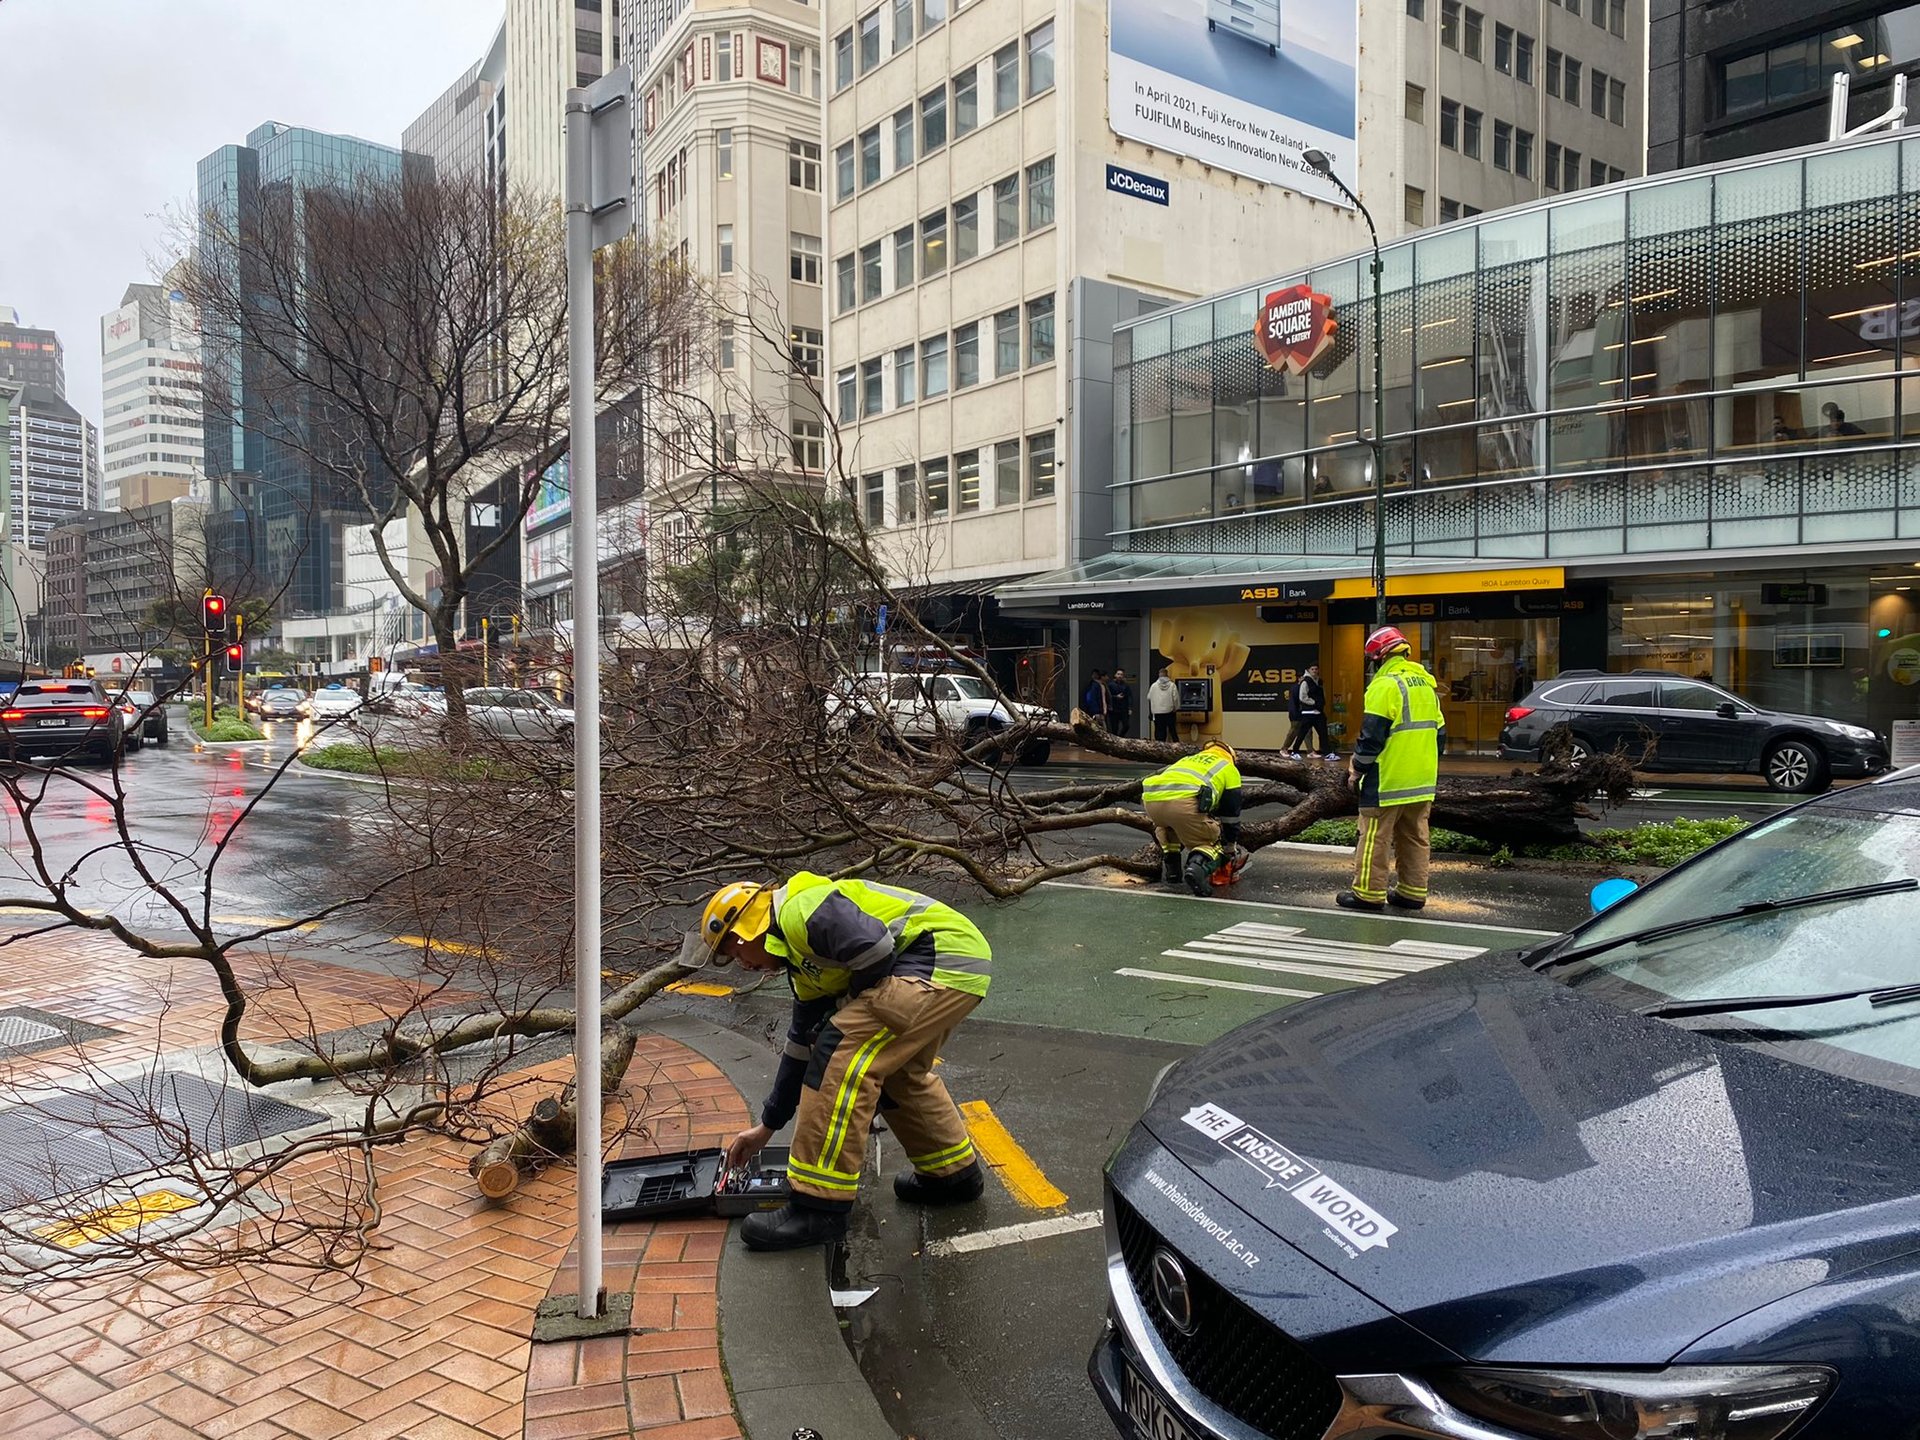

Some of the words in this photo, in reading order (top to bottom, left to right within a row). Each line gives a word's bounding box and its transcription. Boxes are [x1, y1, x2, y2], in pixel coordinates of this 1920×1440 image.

[1134, 81, 1145, 96] In
[1147, 86, 1171, 105] April
[1173, 95, 1200, 116] 2021,
[1202, 105, 1219, 123] Fuji
[1220, 112, 1247, 132] Xerox
[1249, 122, 1268, 138] New
[1270, 129, 1303, 151] Zealand
[1135, 104, 1182, 131] FUJIFILM
[1184, 120, 1226, 147] Business
[1227, 135, 1277, 163] Innovation
[1279, 152, 1299, 170] New
[1110, 171, 1166, 201] JCDecaux
[1268, 297, 1312, 321] LAMBTON
[1268, 312, 1312, 339] SQUARE
[1291, 330, 1312, 344] EATERY
[1241, 587, 1280, 600] ASB
[1288, 589, 1307, 598] Bank
[1500, 579, 1531, 587] Lambton
[1532, 578, 1551, 586] Quay
[1067, 602, 1090, 610] Lambton
[1090, 601, 1105, 609] Quay
[1386, 603, 1435, 617] ASB
[1447, 605, 1471, 616] Bank
[1563, 600, 1585, 609] ASB
[1247, 668, 1297, 684] ASB
[1195, 1109, 1231, 1132] THE
[1232, 1132, 1304, 1181] INSIDE
[1143, 1168, 1261, 1269] www.theinsideword.ac.nz
[1309, 1185, 1380, 1239] WORD
